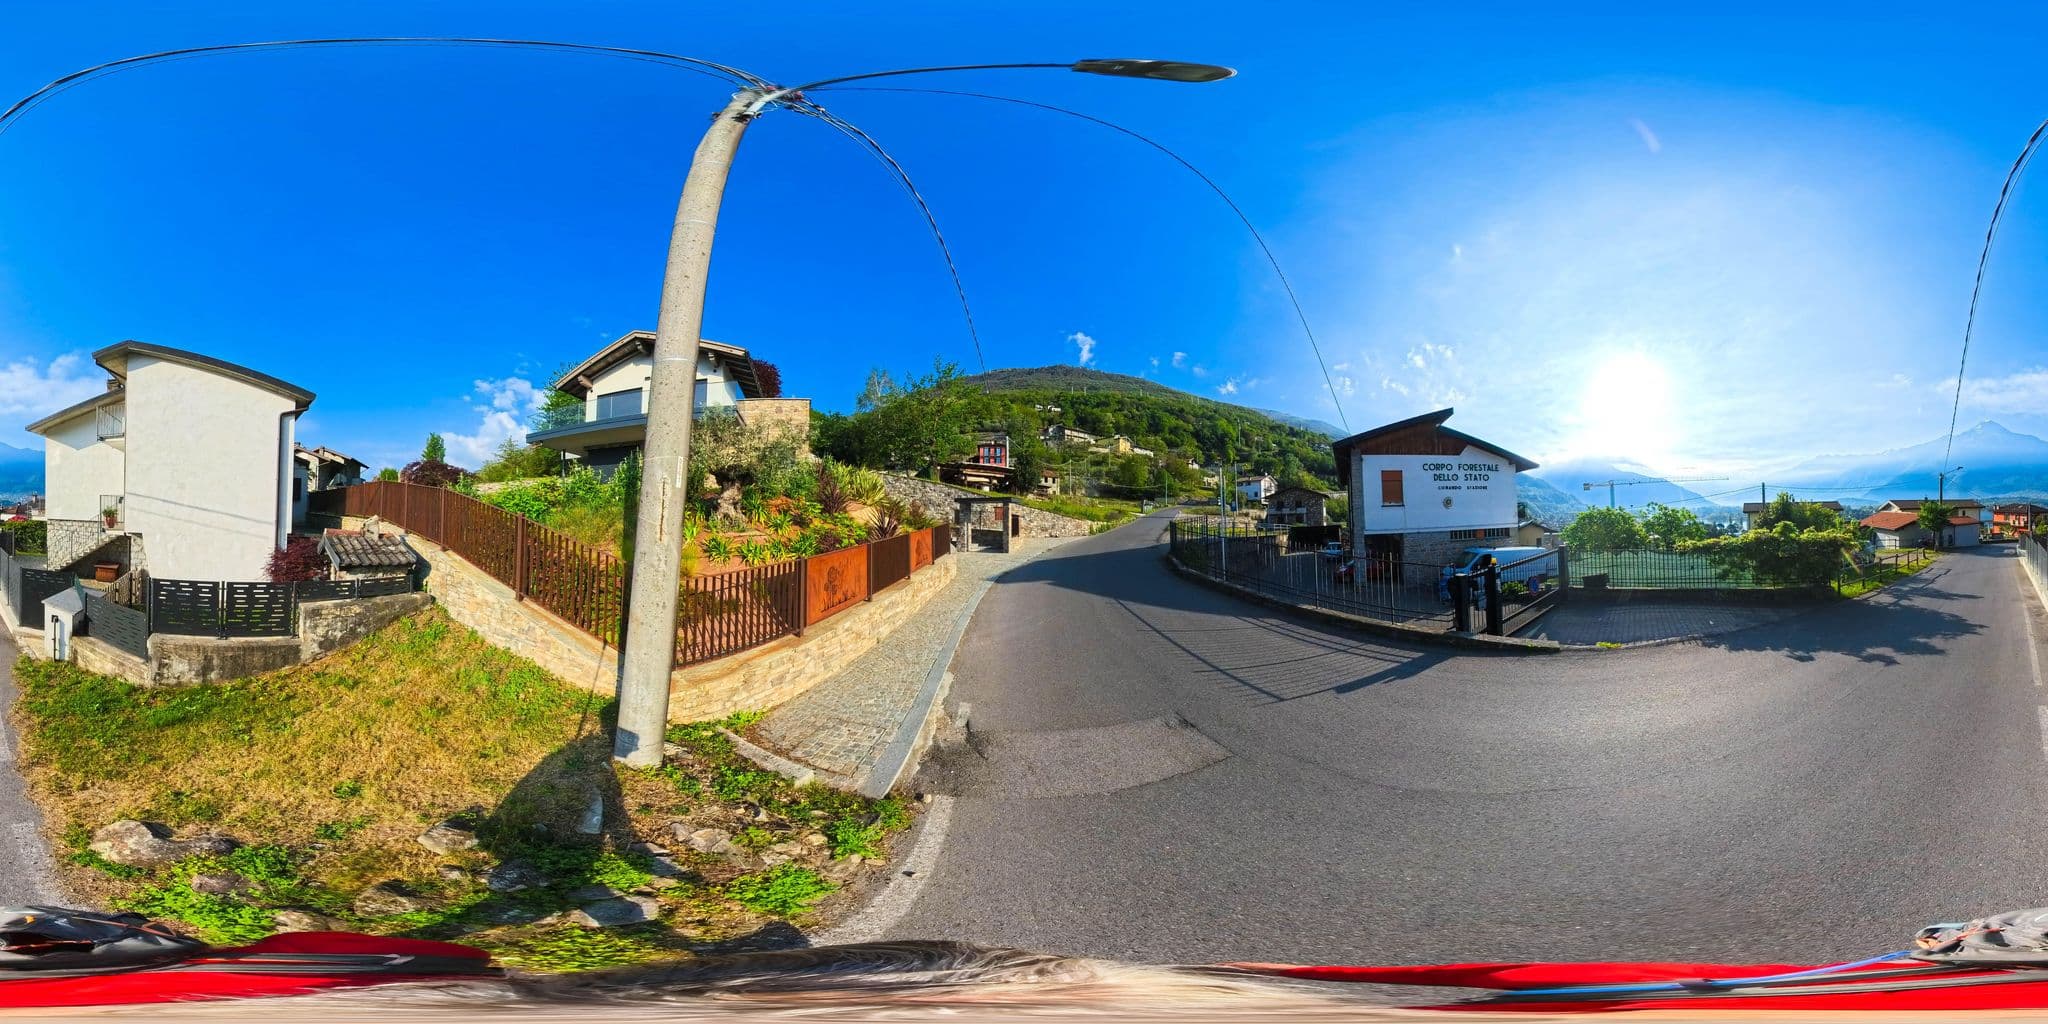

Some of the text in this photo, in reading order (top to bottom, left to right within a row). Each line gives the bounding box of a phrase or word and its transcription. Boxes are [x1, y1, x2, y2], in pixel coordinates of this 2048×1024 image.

[1422, 463, 1500, 472] CORPO FORESTALE
[1433, 473, 1490, 482] DELLO STATO
